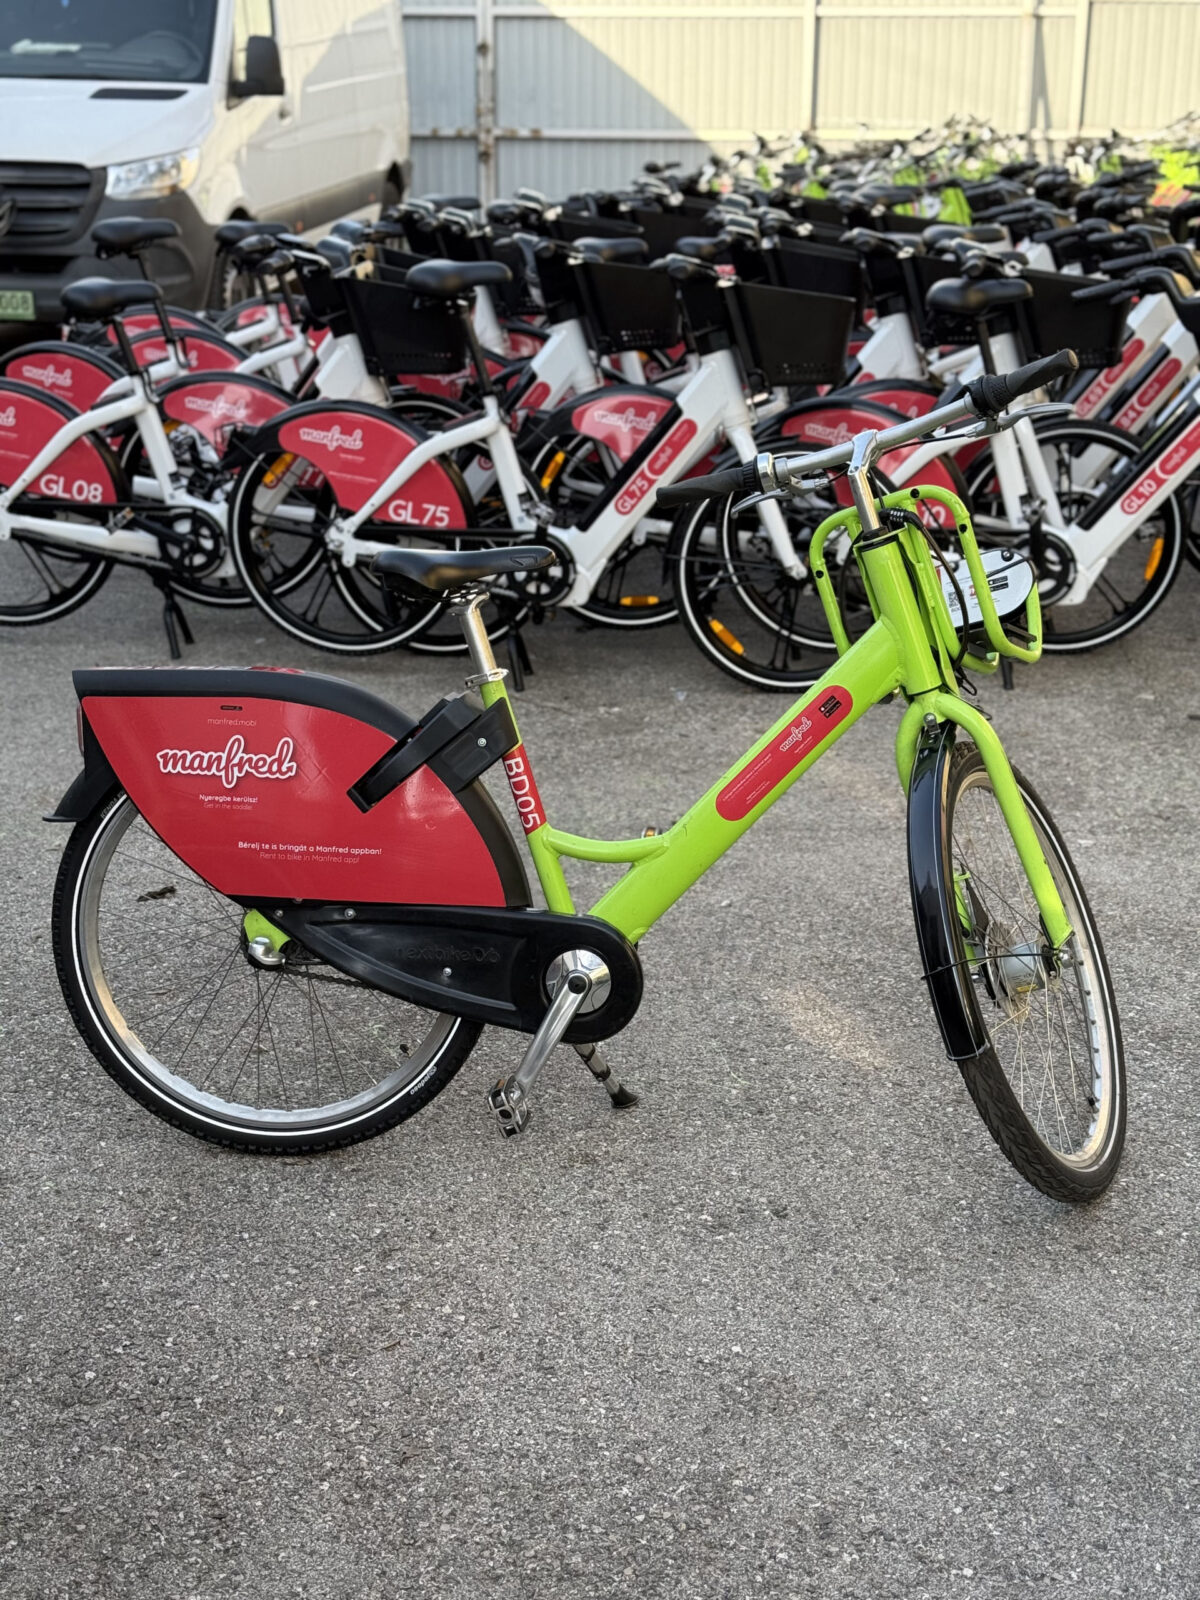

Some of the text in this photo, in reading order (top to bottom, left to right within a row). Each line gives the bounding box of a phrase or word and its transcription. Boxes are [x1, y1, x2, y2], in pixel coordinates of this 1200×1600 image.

[299, 425, 363, 451] manfred
[39, 473, 103, 503] GL08
[617, 477, 649, 513] GL75
[388, 500, 450, 527] GL75
[207, 717, 257, 727] manfred.mobi
[780, 716, 812, 751] manfred
[156, 734, 297, 788] manfred
[199, 794, 232, 803] Nyeregbe
[504, 757, 541, 828] BD05
[238, 841, 260, 851] Bérelj
[279, 844, 307, 853] bringát
[316, 844, 349, 854] Manfred
[350, 847, 382, 855] appban!
[312, 854, 342, 863] Manfred
